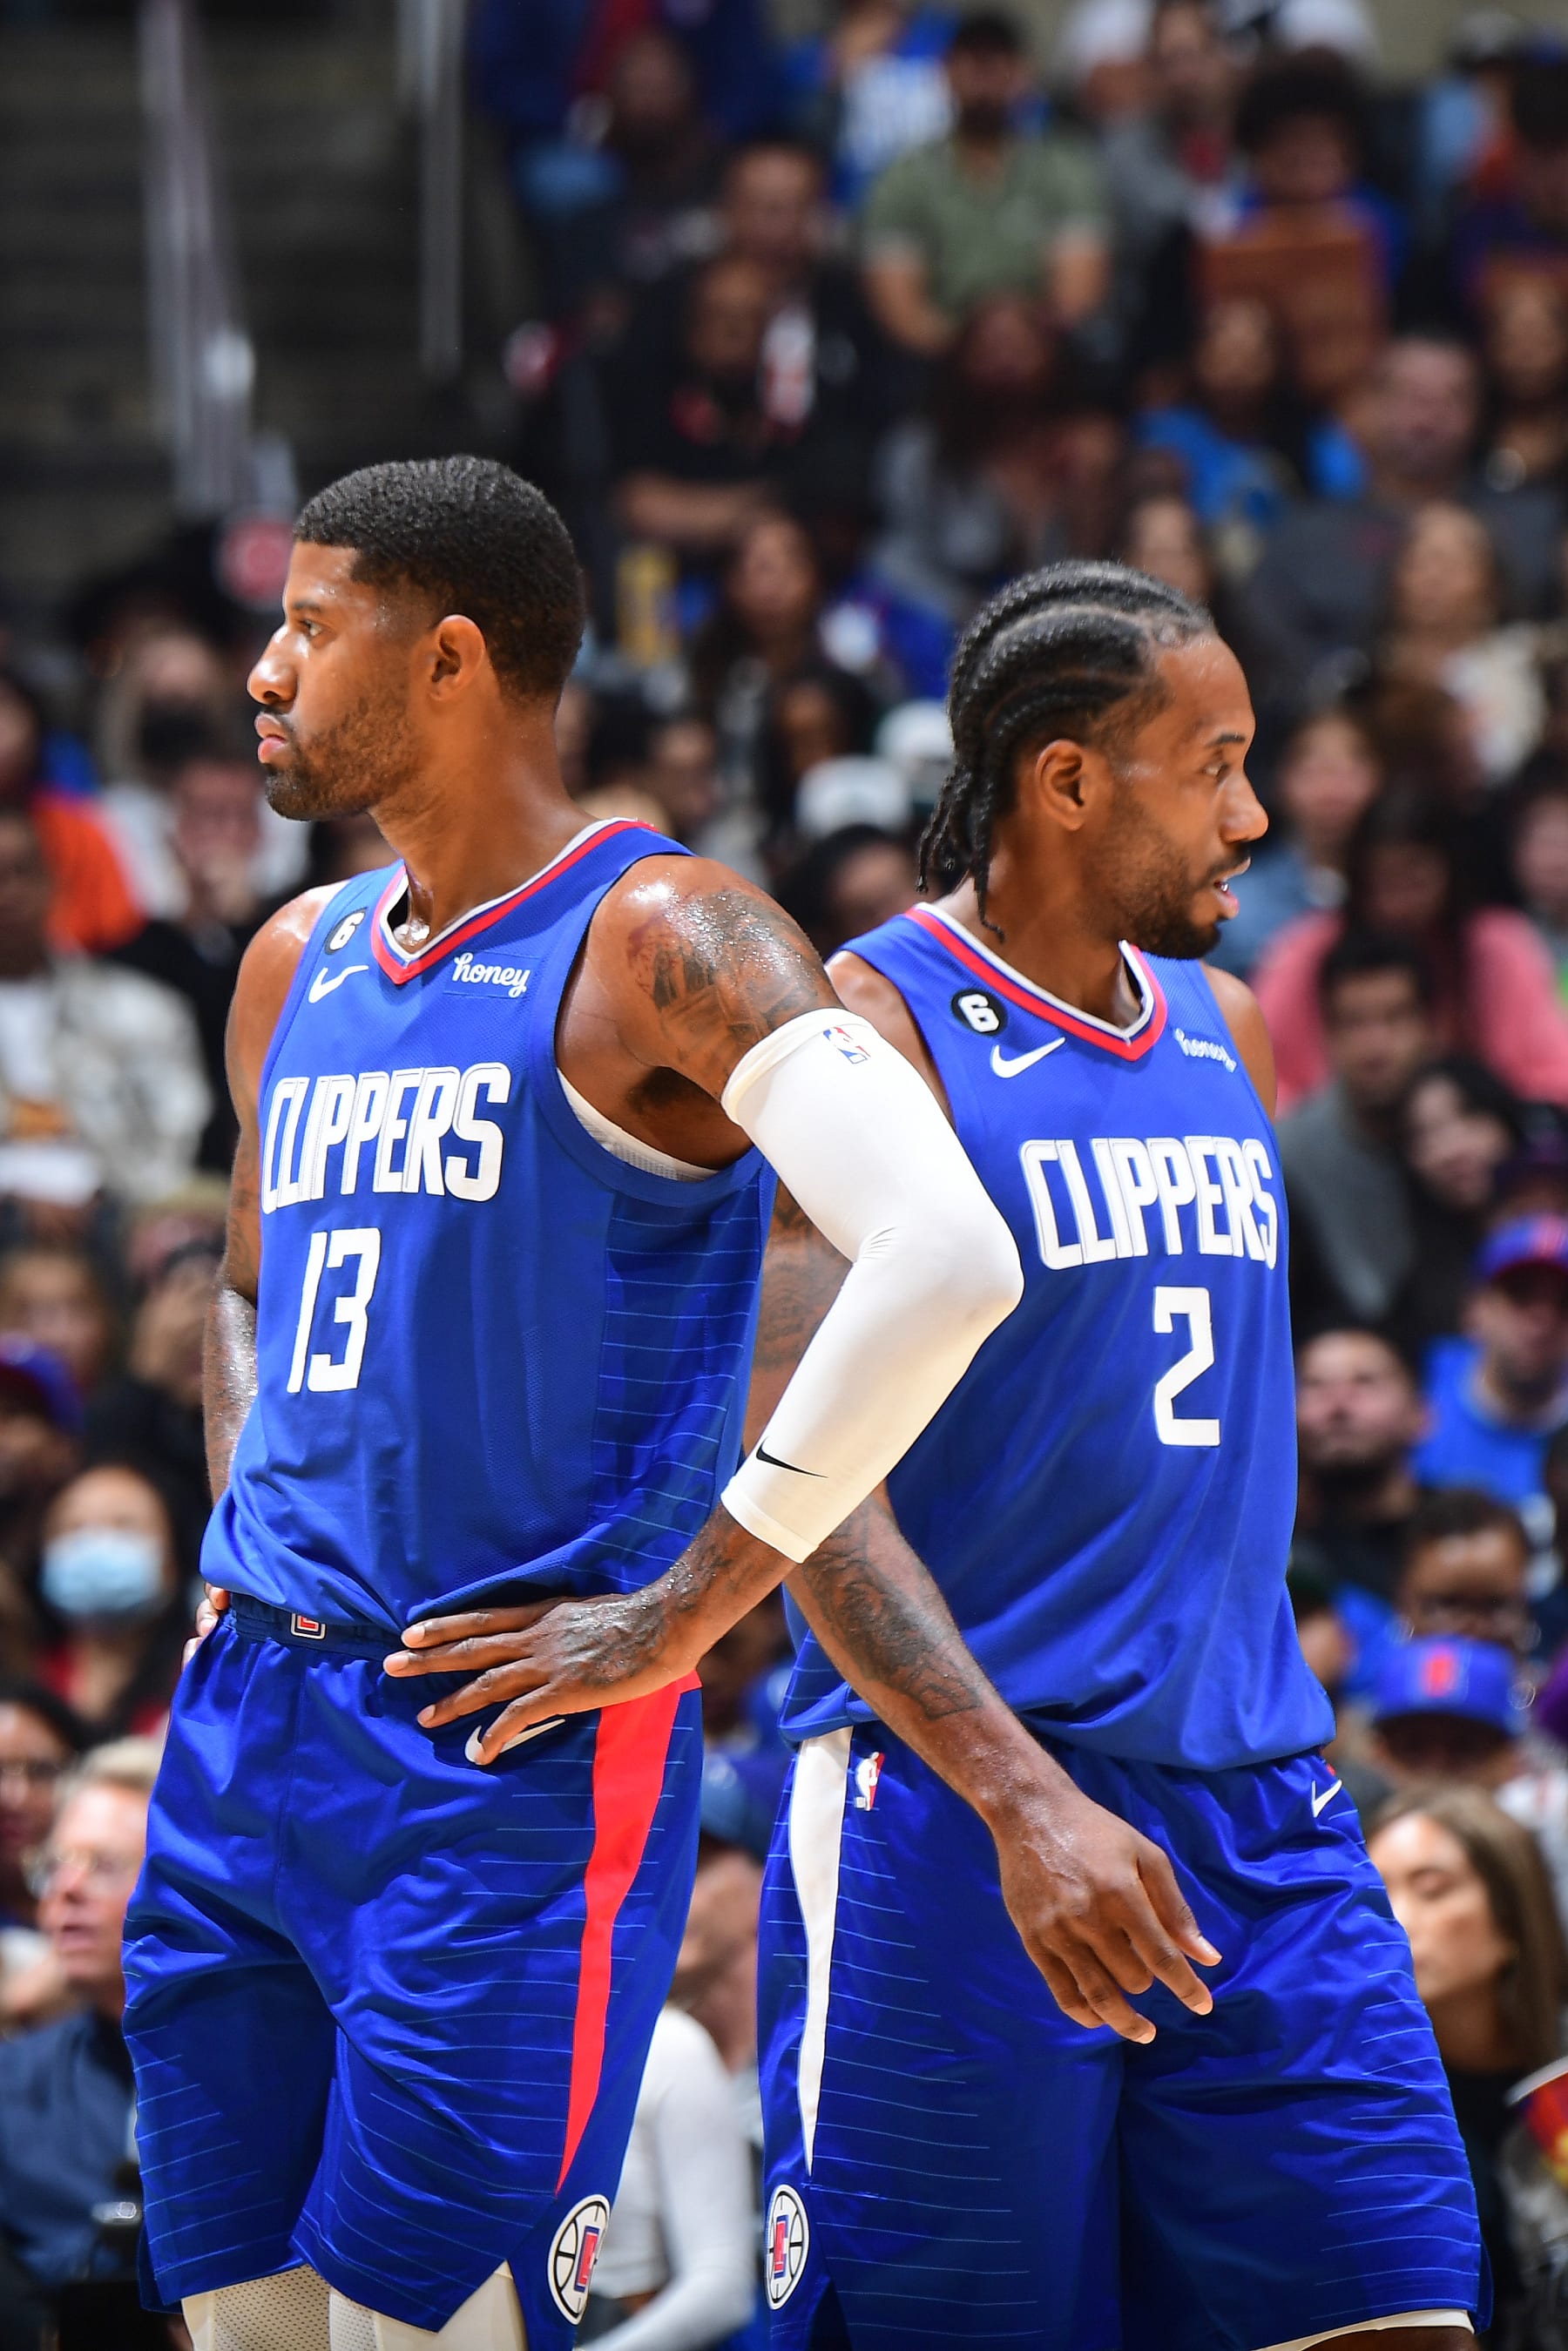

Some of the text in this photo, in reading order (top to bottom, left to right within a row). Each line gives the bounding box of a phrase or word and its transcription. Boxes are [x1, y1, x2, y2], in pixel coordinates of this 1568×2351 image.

[329, 911, 365, 950] 6
[452, 952, 531, 998] honey
[957, 993, 1000, 1033] 6
[262, 1062, 511, 1215] CLIPPERS
[1019, 1135, 1278, 1270] CLIPPERS
[286, 1226, 382, 1394] 13
[1153, 1285, 1221, 1447] 2
